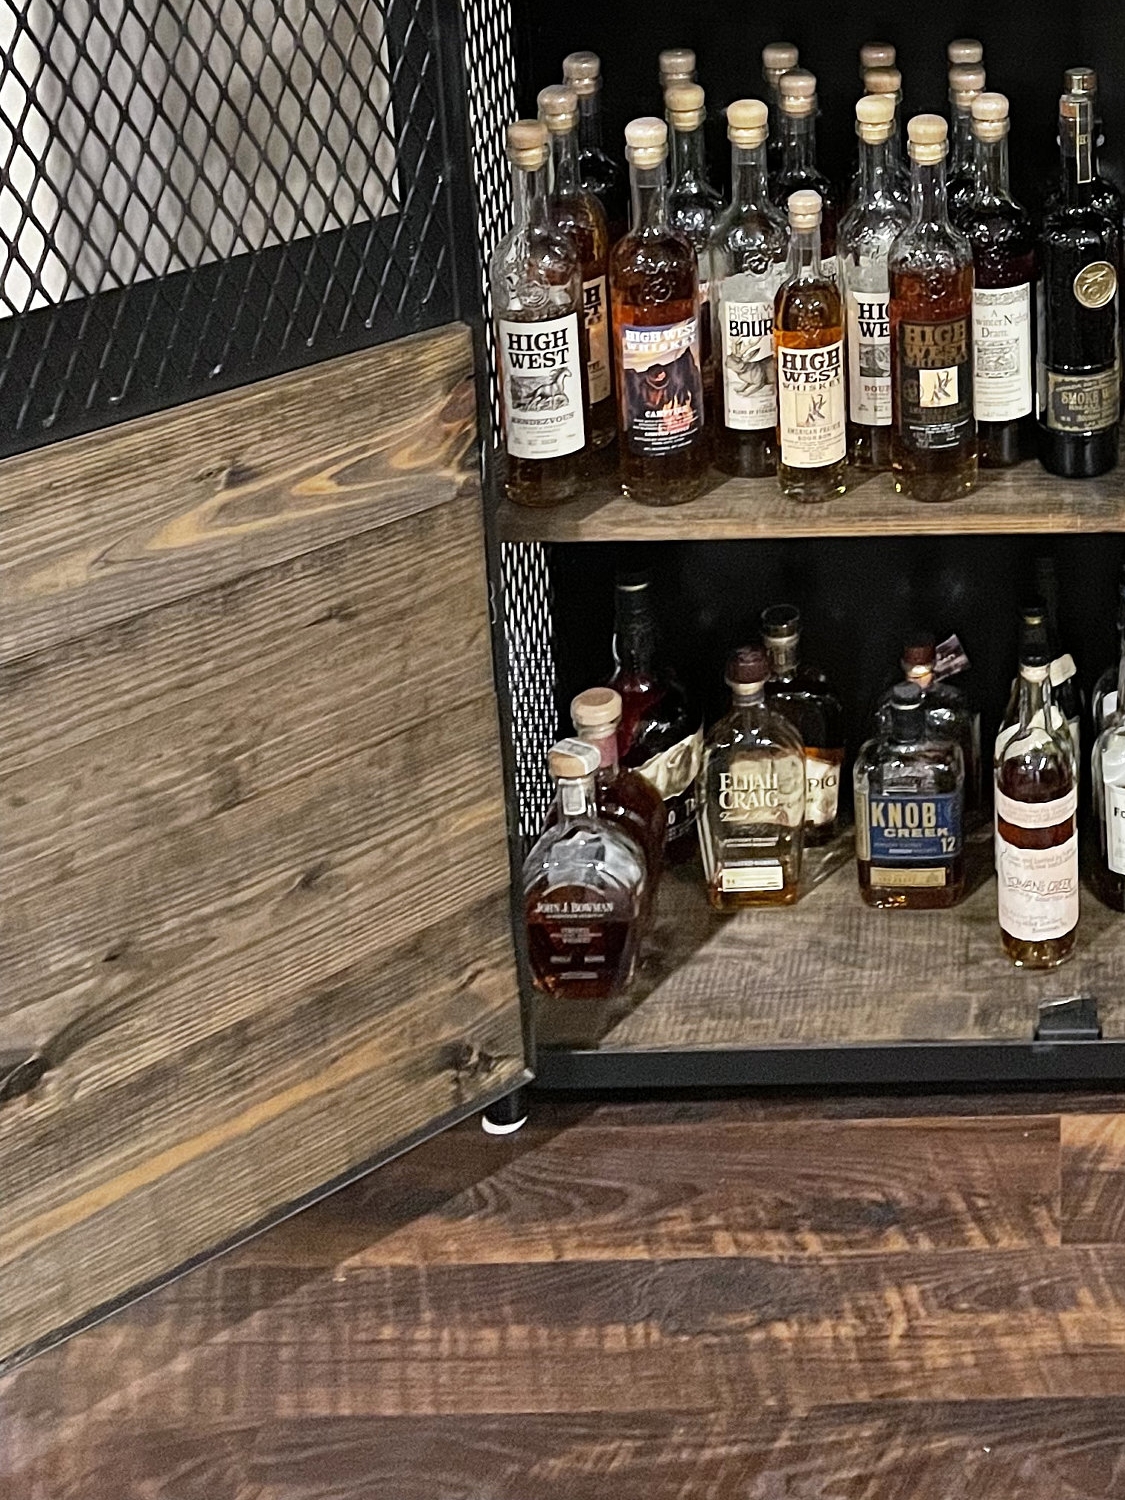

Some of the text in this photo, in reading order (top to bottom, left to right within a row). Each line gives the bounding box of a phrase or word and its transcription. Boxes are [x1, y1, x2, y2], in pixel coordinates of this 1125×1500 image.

[728, 304, 759, 315] HIGH
[857, 302, 890, 320] HI
[625, 319, 697, 343] HIGH WEST
[729, 319, 773, 338] BOUR
[858, 321, 890, 338] WE
[903, 319, 968, 346] HIGH
[507, 327, 569, 352] HIGH
[508, 347, 570, 369] WEST
[781, 346, 841, 371] HIGH
[782, 364, 841, 384] WEST
[782, 378, 842, 391] WHISKEY
[1061, 389, 1100, 405] SMOKE
[511, 411, 576, 426] RENDEZVOUS
[719, 772, 779, 792] ELIJAH
[718, 790, 779, 810] CRAIG
[871, 802, 937, 828] KNOB
[884, 827, 949, 838] CREEK
[941, 836, 956, 853] 12
